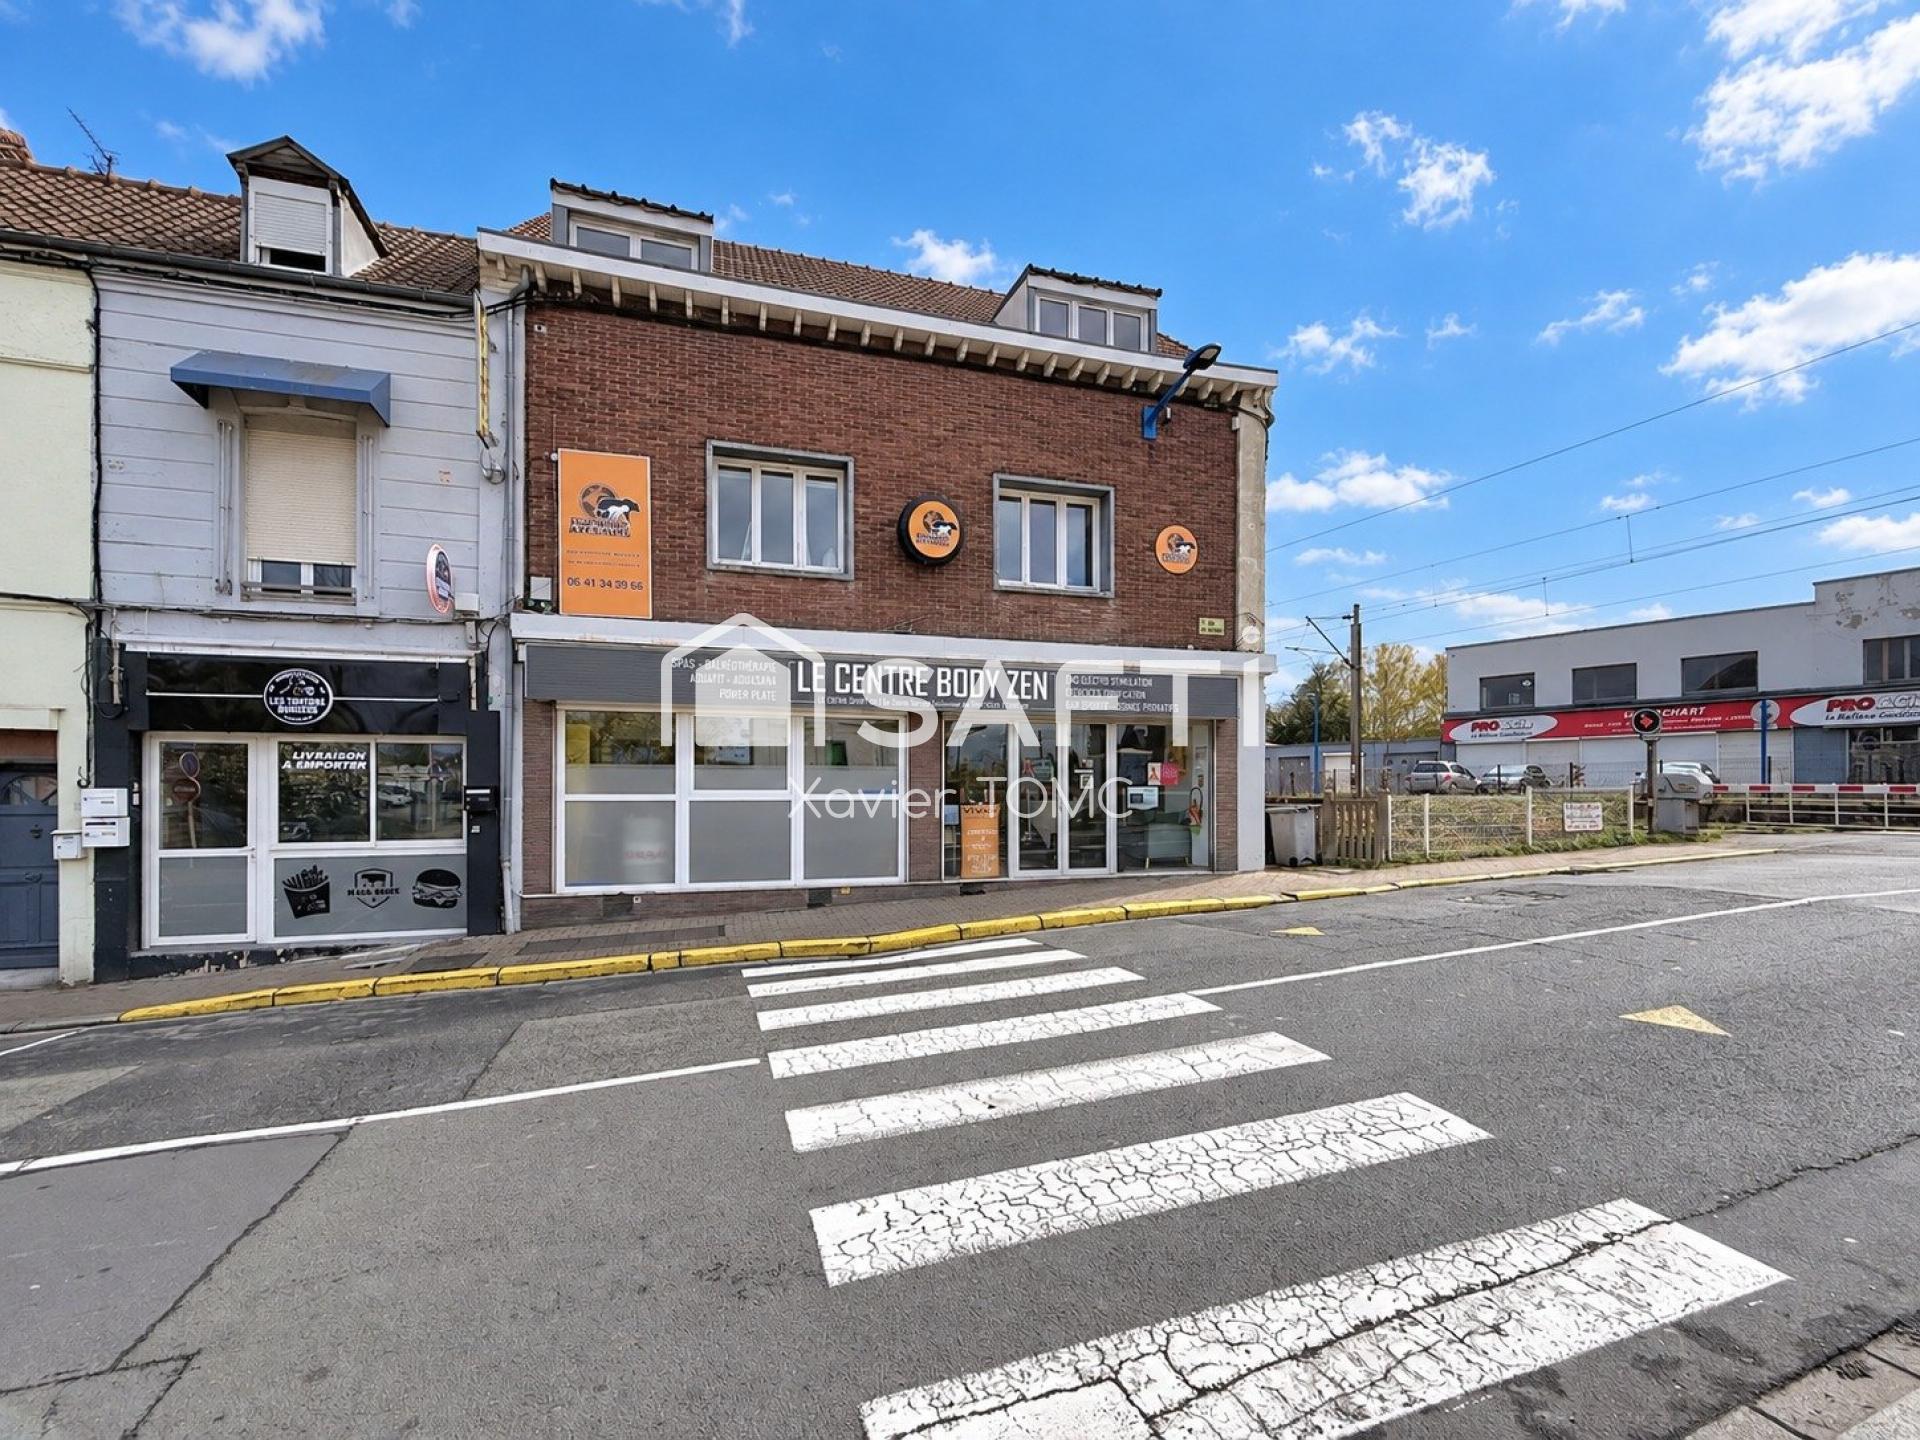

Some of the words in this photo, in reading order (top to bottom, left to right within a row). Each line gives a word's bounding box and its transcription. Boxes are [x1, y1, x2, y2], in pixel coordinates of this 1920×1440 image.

[567, 577, 581, 587] 06
[584, 578, 595, 588] 41
[600, 578, 612, 588] 34
[798, 661, 826, 693] LE
[834, 663, 928, 697] CENTRE
[936, 666, 999, 699] BODY
[1006, 670, 1047, 700] ZEN
